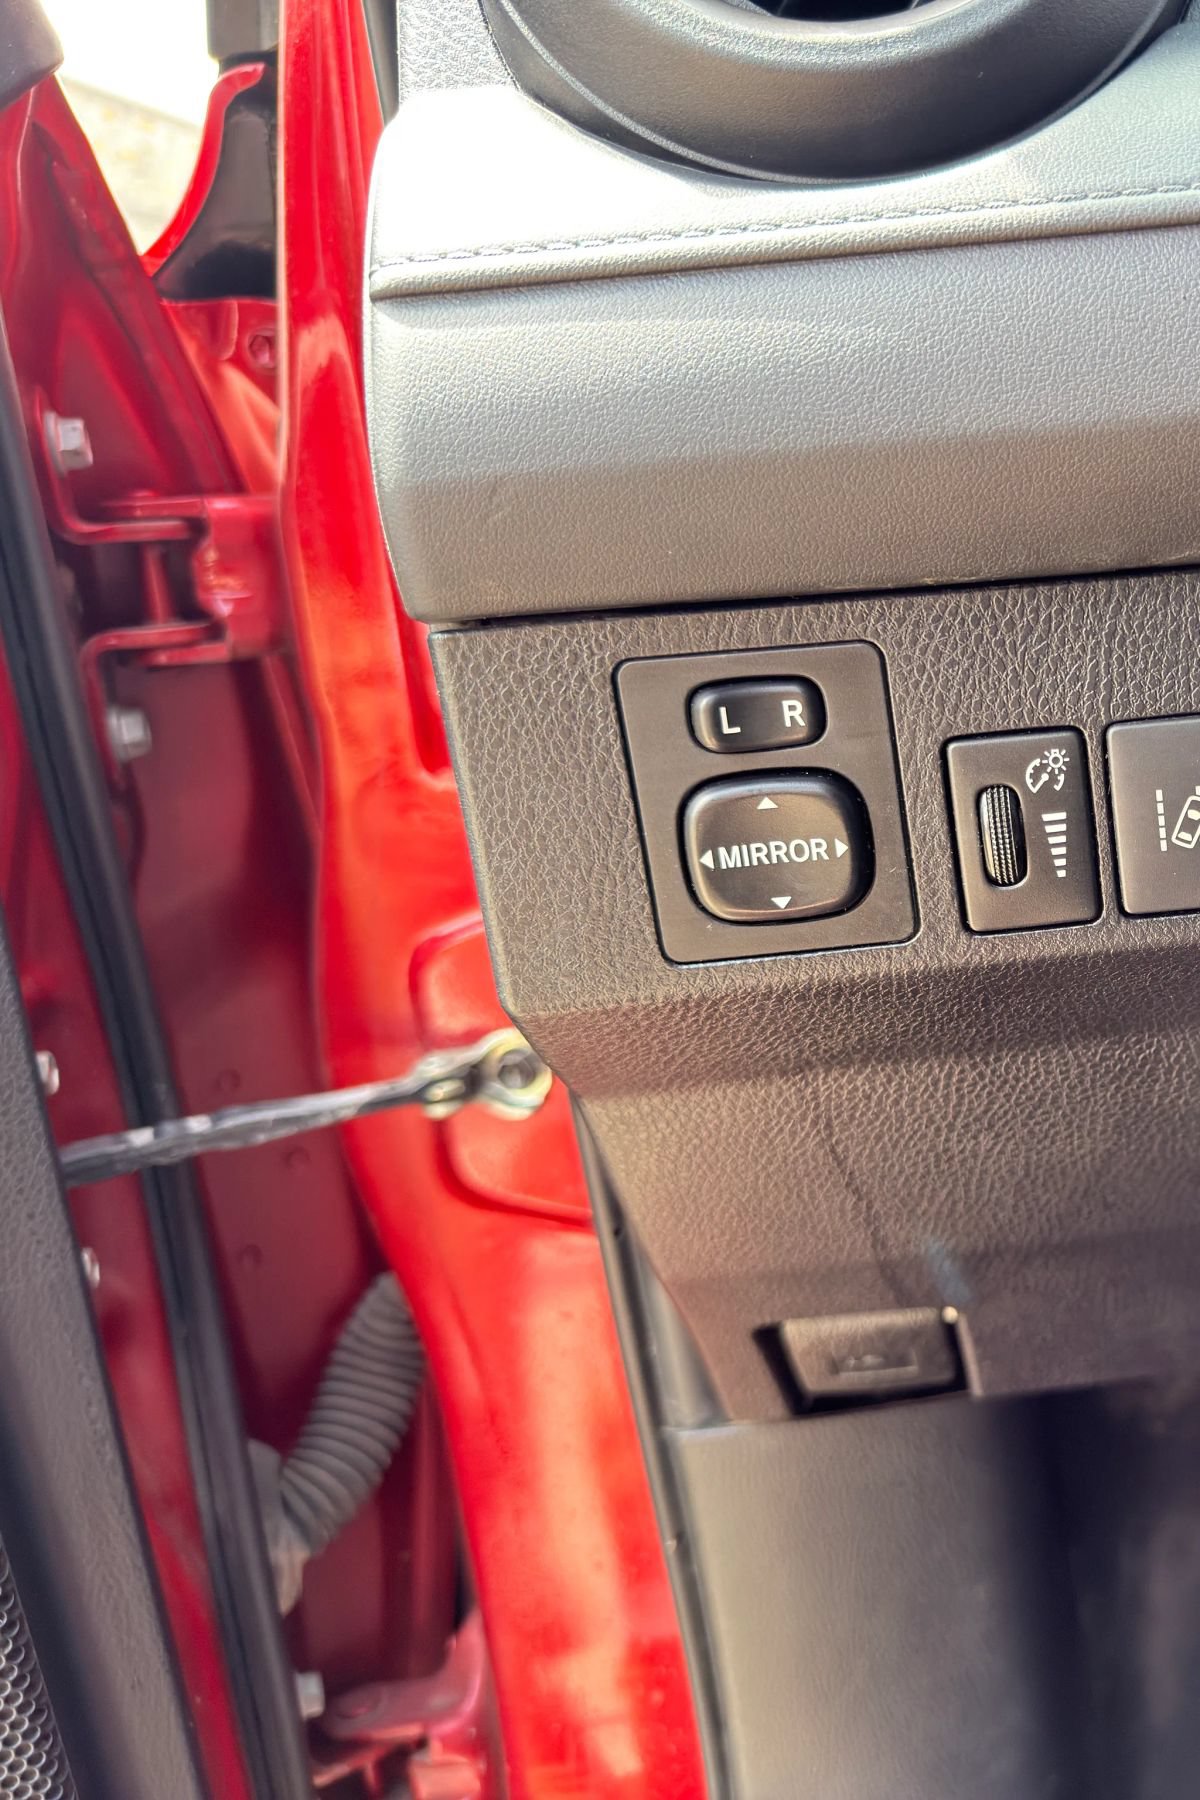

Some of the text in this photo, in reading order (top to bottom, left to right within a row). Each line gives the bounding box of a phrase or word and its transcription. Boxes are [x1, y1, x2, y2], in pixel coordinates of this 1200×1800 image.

[719, 699, 805, 734] L R
[717, 837, 830, 870] MIRROR
